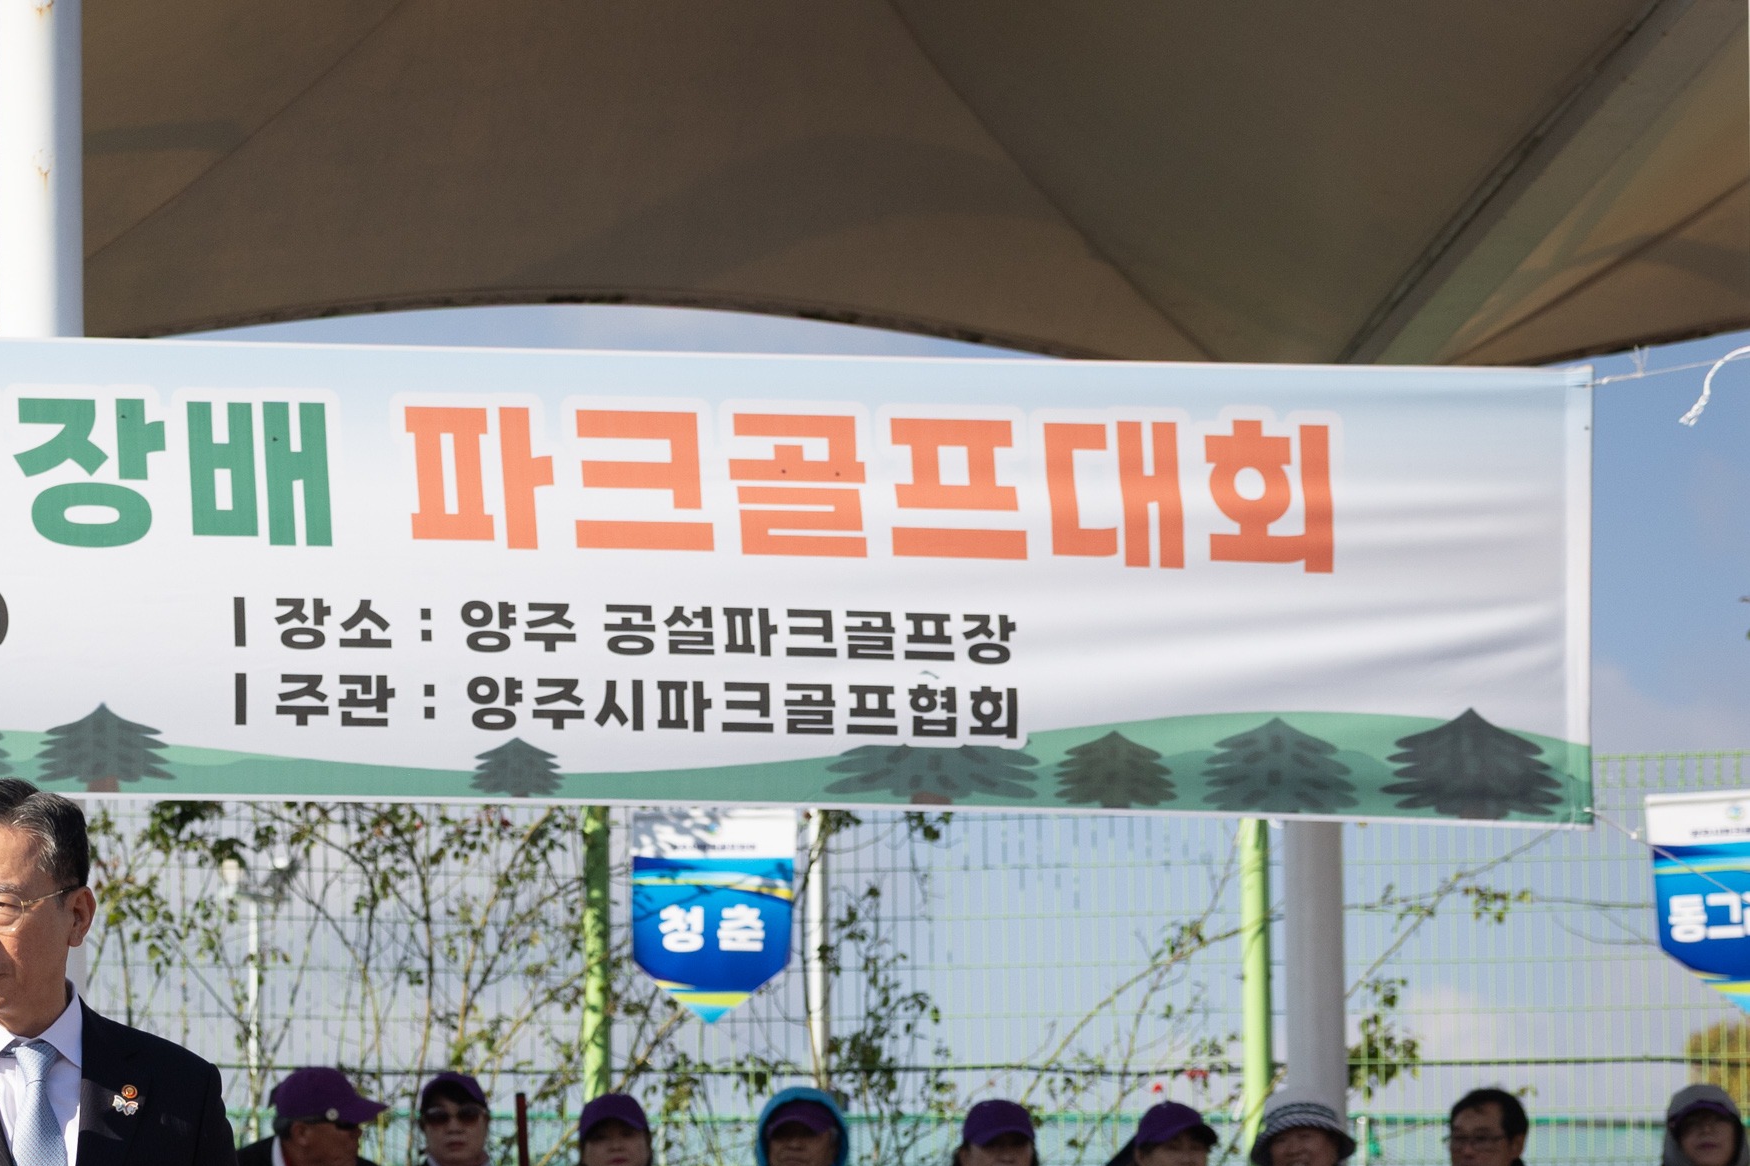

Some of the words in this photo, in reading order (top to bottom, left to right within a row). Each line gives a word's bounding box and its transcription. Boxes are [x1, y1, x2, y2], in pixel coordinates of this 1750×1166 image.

[404, 406, 1334, 574] 파크골프대회
[274, 597, 392, 650] 장소
[460, 600, 577, 653] 양주
[604, 604, 1017, 665] 공설파크골프장
[276, 673, 396, 728] 주관
[467, 676, 1018, 740] 양주시파크골프협회
[658, 903, 766, 953] 청춘
[1667, 891, 1750, 944] 동그
